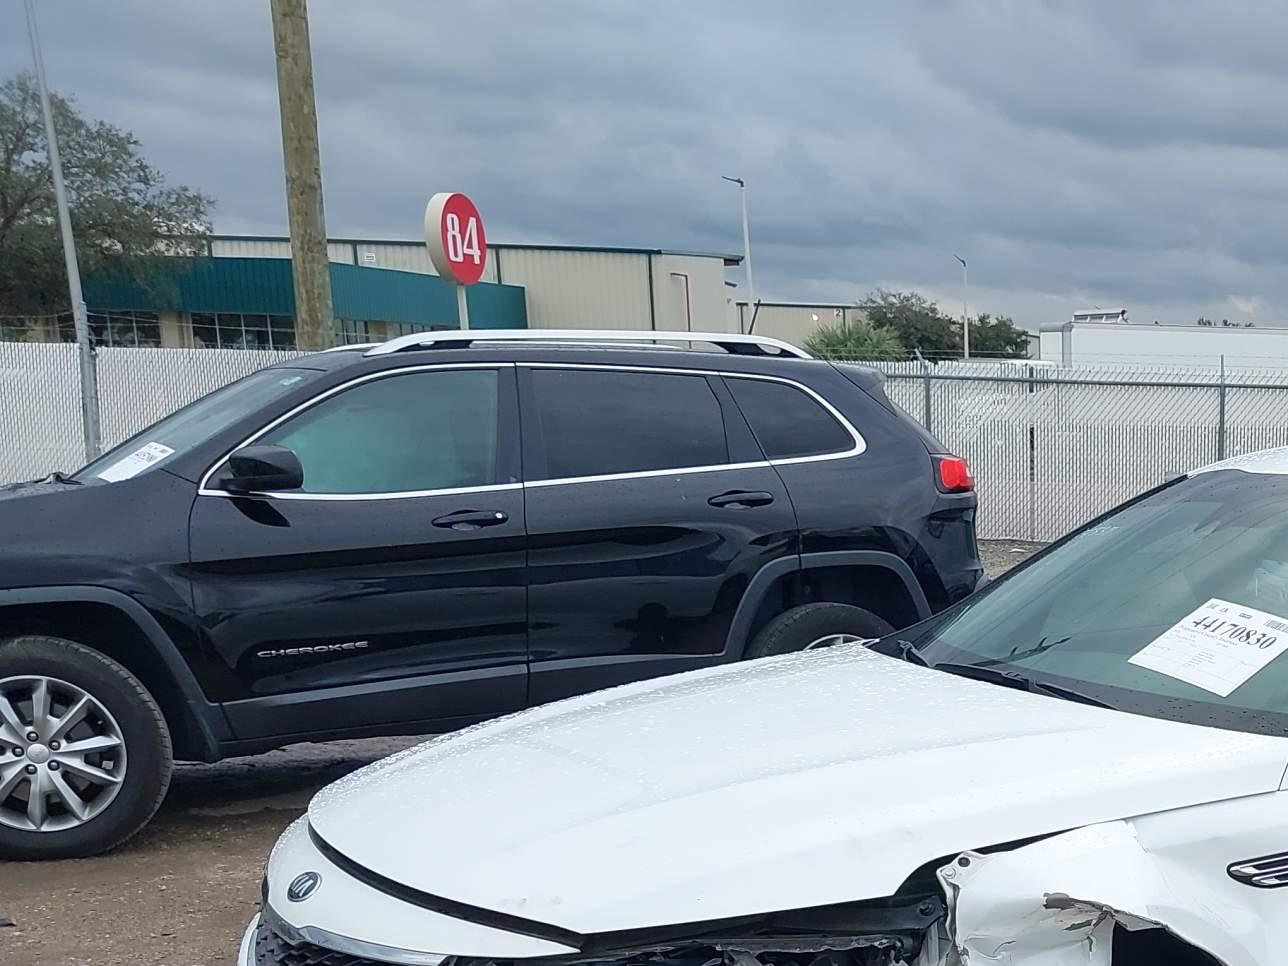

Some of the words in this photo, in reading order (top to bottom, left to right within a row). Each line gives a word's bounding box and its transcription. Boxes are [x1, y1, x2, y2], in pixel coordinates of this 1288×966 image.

[447, 213, 480, 264] 84
[257, 641, 368, 657] CHEROKEE
[1193, 615, 1278, 650] 44170830
